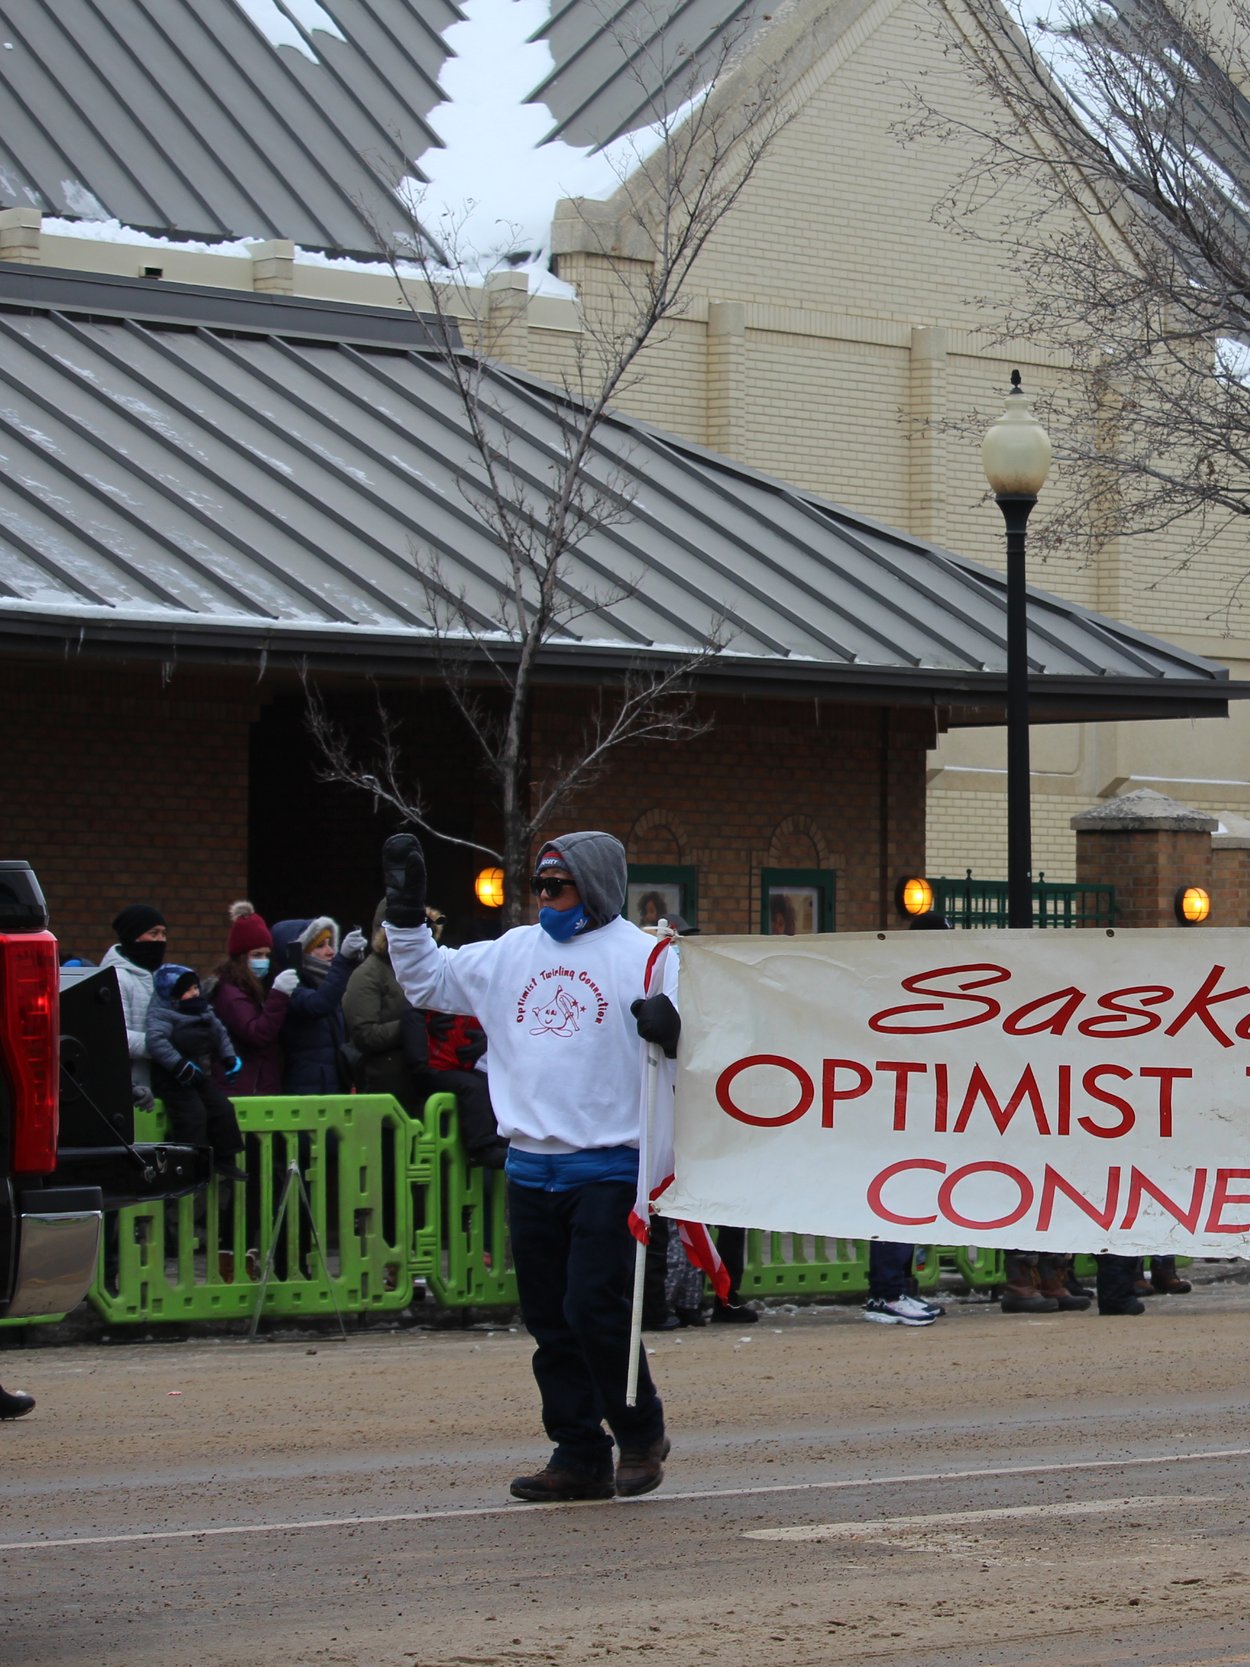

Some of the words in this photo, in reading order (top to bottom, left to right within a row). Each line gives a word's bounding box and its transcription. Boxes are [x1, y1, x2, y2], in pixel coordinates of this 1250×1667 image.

[516, 977, 538, 1024] Optimist
[539, 965, 576, 981] Twirling
[578, 971, 609, 1025] Connection
[717, 1054, 1193, 1137] OPTIMIST
